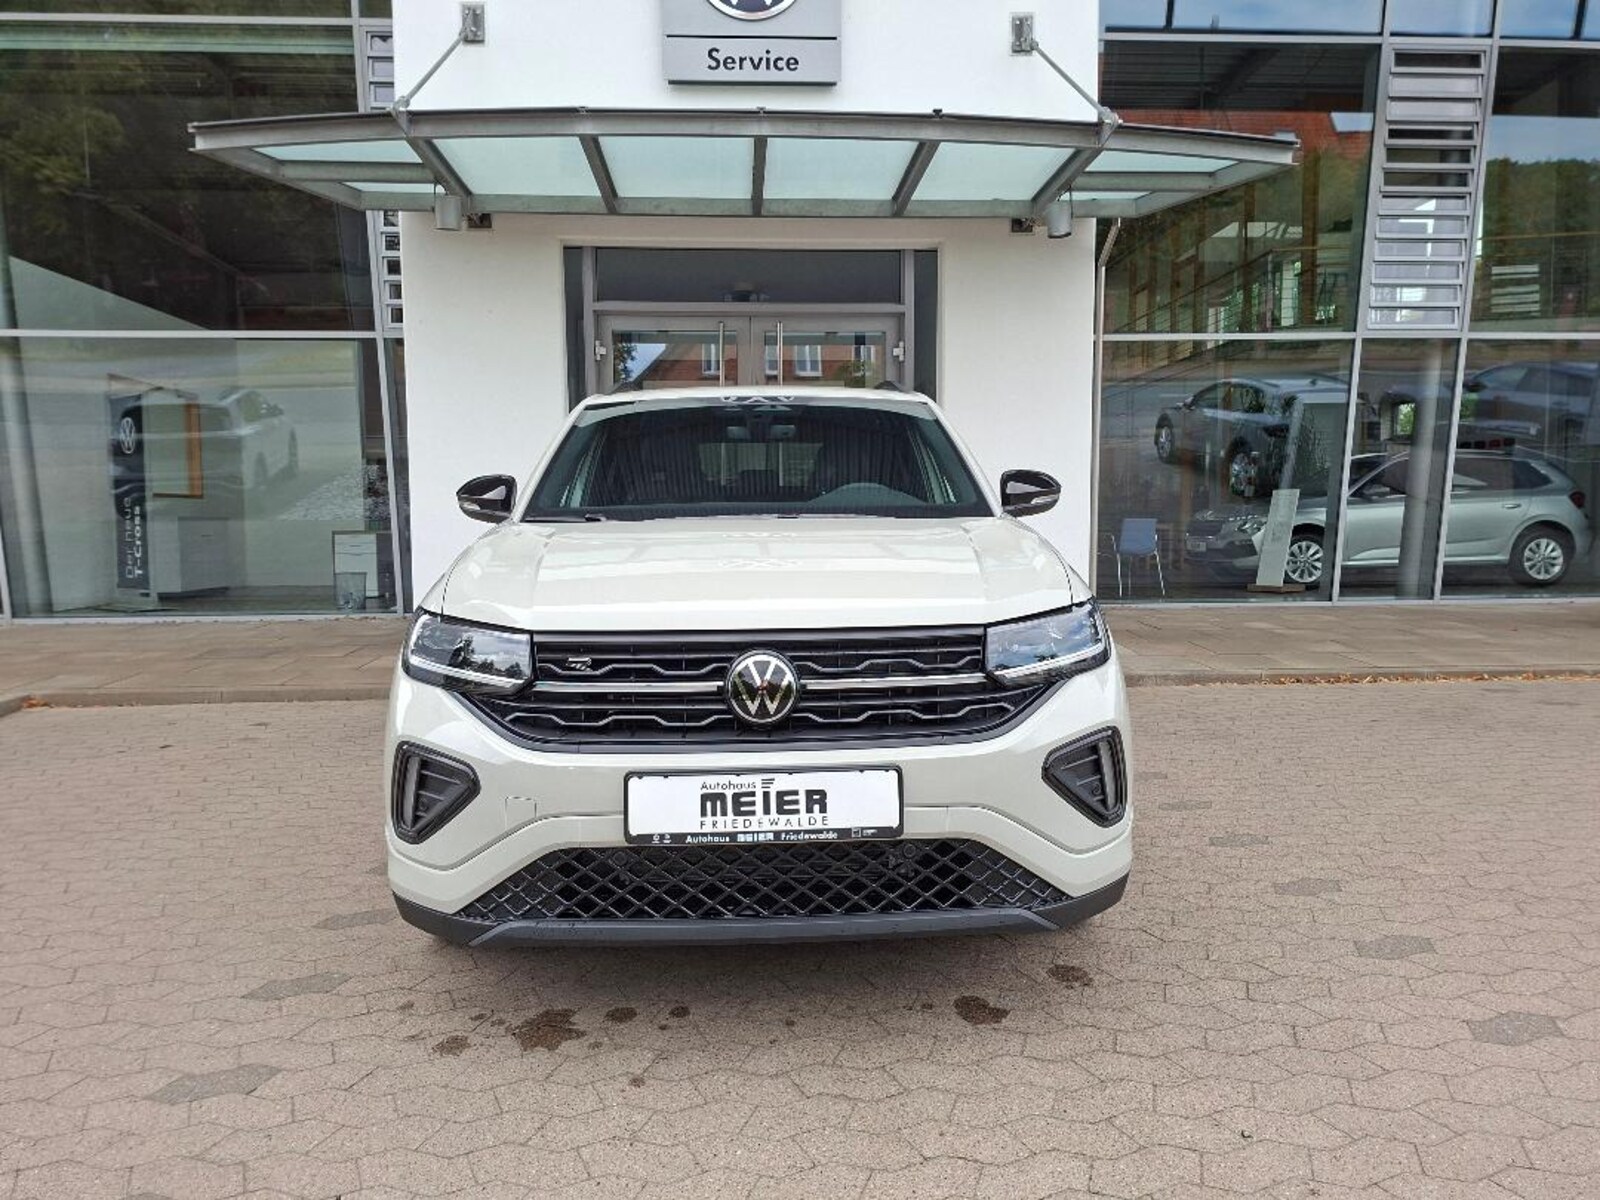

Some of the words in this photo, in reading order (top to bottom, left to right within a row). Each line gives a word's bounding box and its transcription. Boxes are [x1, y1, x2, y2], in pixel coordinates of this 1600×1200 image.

[707, 47, 799, 71] Service
[134, 506, 143, 577] T-Cross
[729, 651, 797, 722] VW
[700, 780, 756, 790] Autohaus
[700, 788, 828, 818] MEIER
[700, 816, 828, 829] FRIEDEWALDE
[685, 835, 730, 844] Autohaus
[781, 831, 838, 841] Friedewalde
